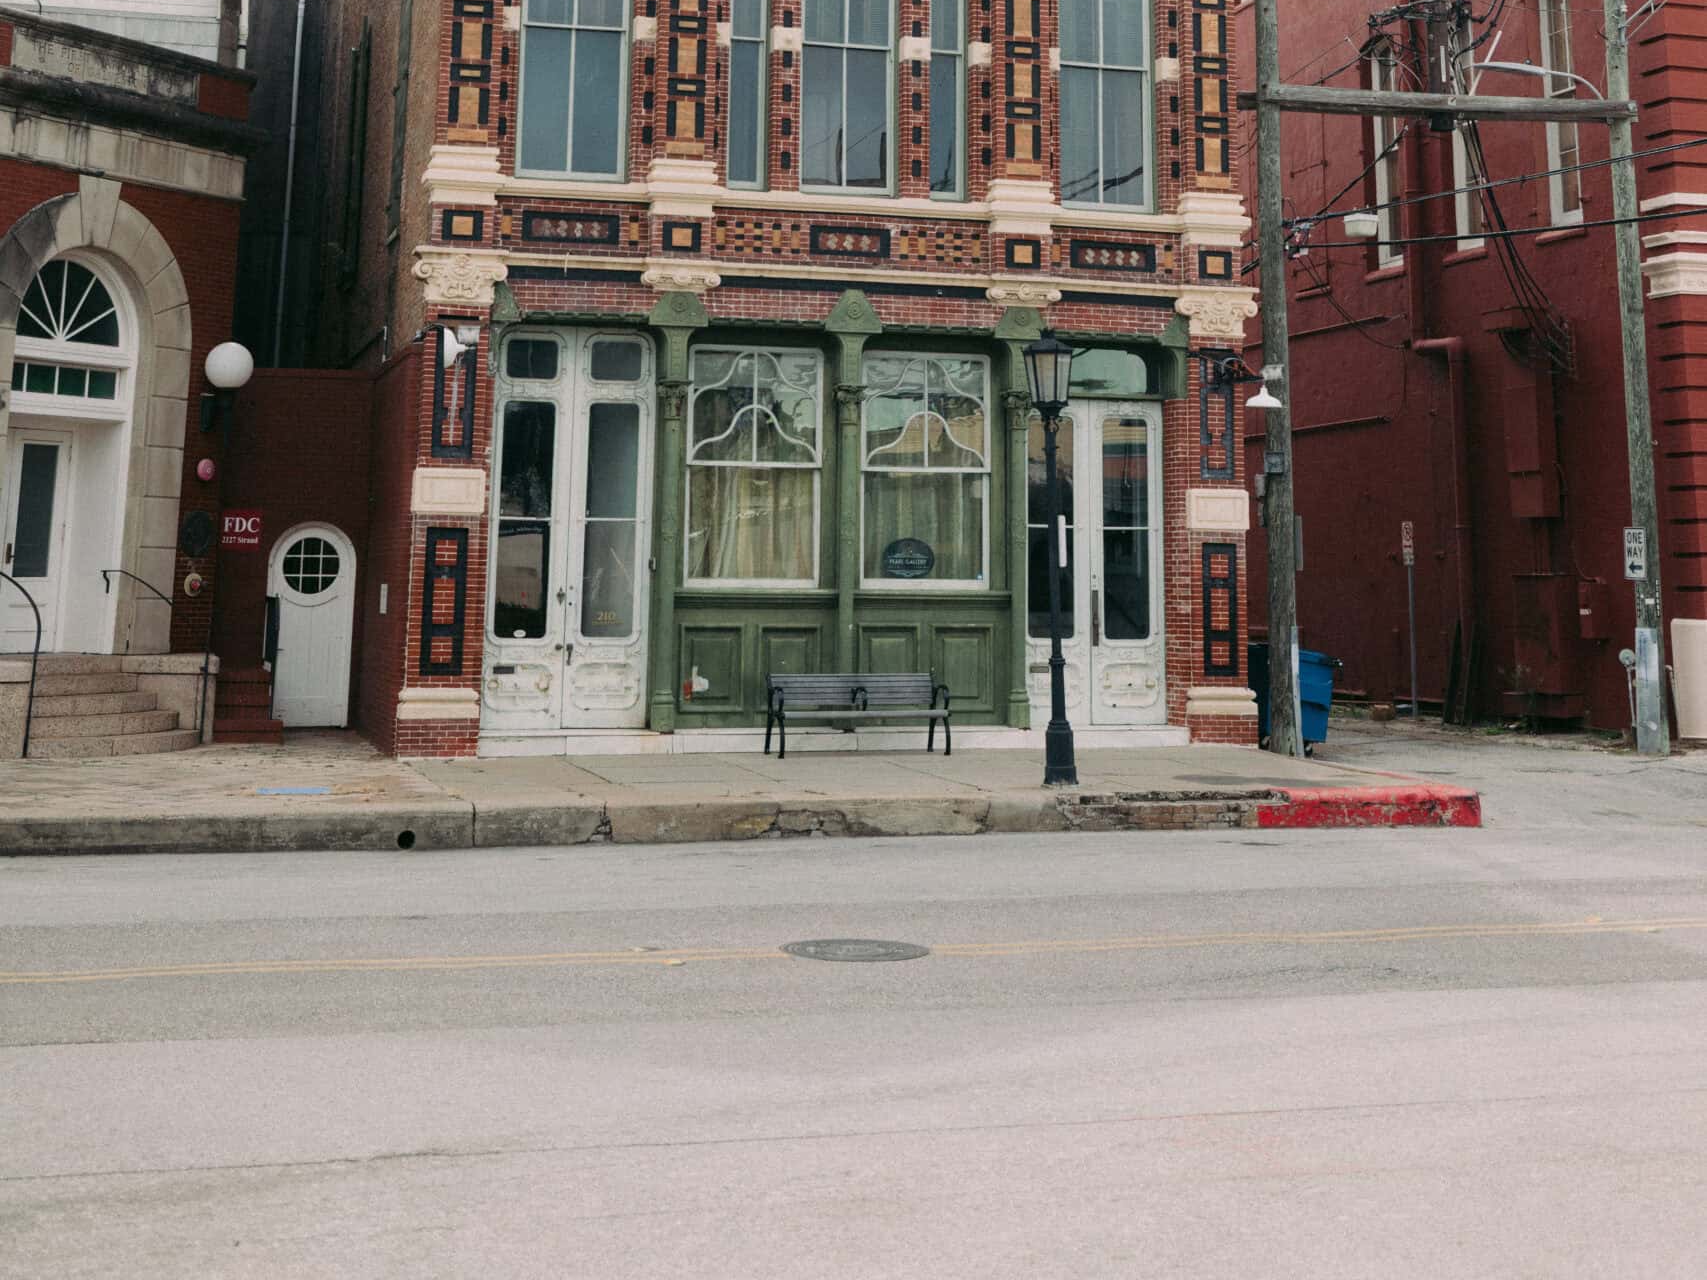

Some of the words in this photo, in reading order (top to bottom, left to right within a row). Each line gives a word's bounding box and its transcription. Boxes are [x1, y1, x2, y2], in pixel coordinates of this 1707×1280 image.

[224, 517, 260, 533] FDC
[1627, 531, 1643, 544] ONE
[1627, 546, 1642, 558] WAY
